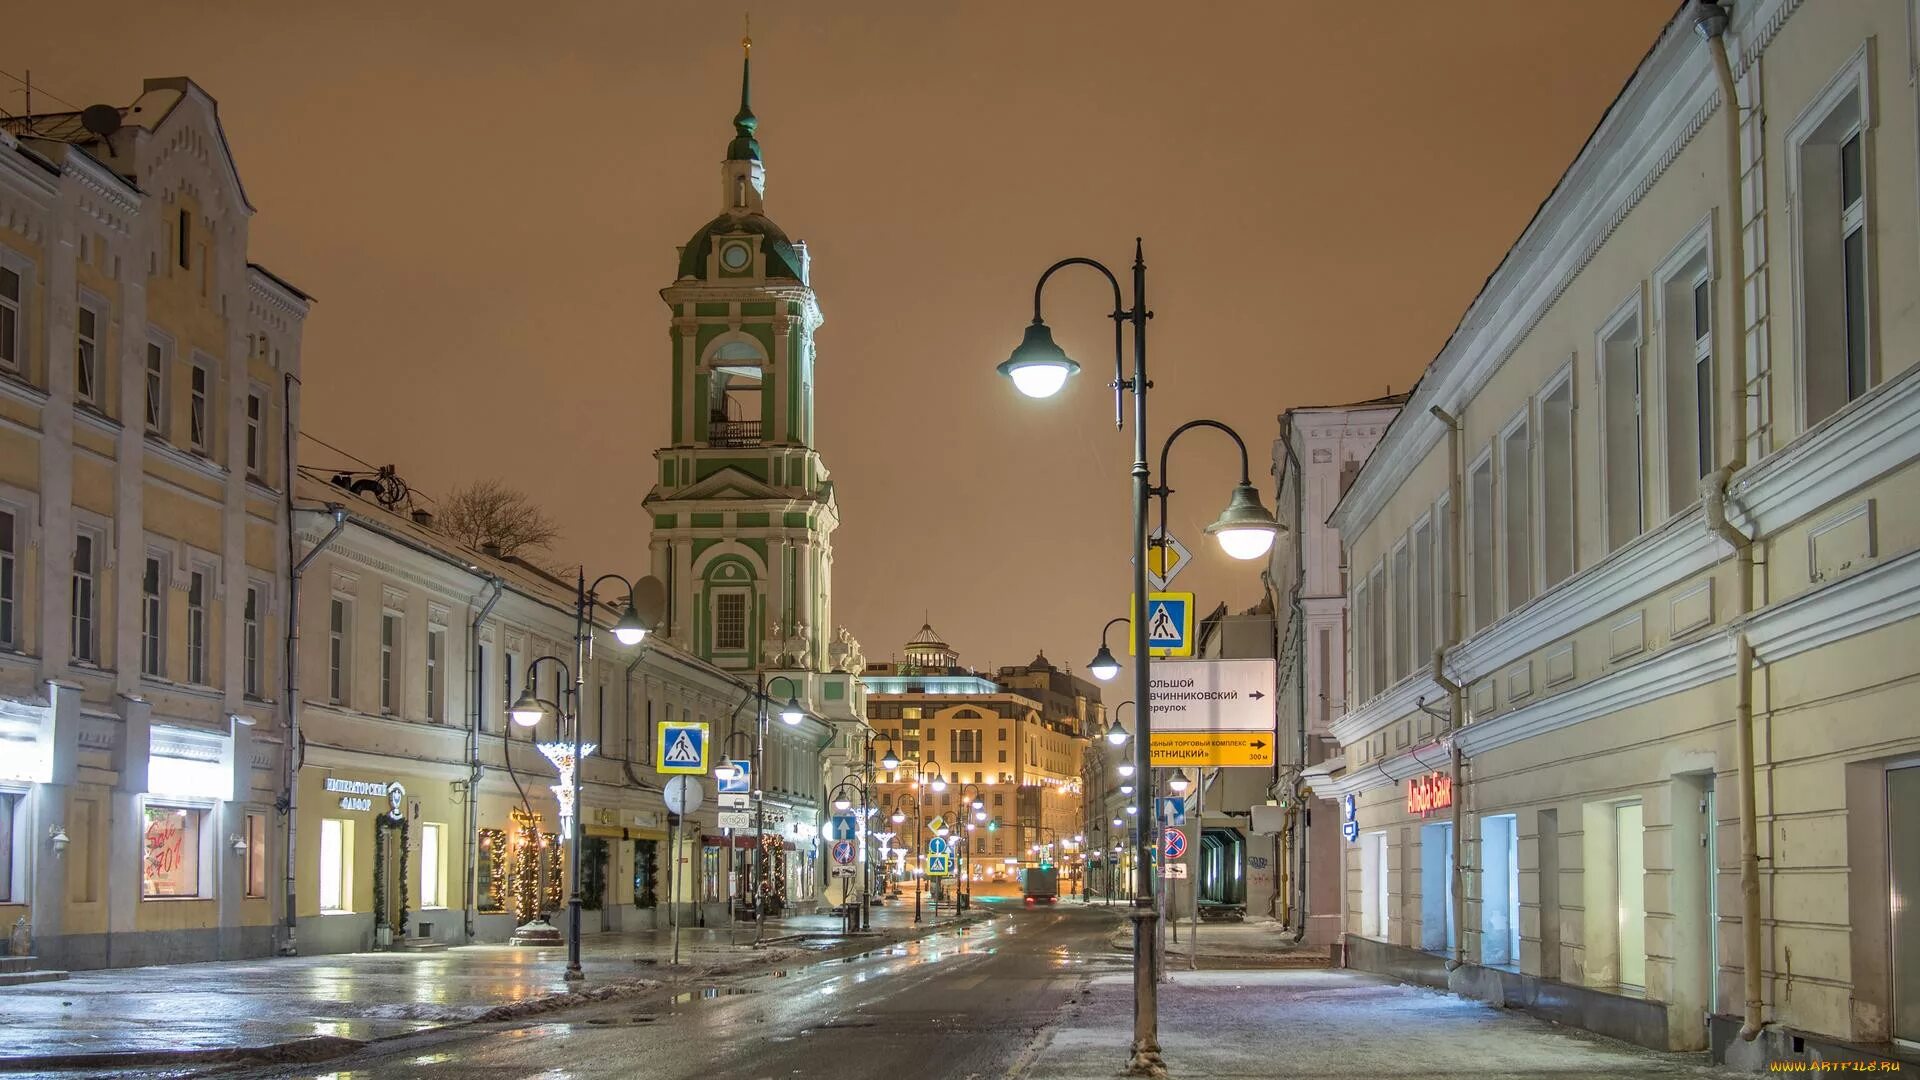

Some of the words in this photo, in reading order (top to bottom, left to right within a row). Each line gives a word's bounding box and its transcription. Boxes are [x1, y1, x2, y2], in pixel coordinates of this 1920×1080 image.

[1149, 679, 1194, 688] ОЛЬШОЙ
[1150, 690, 1238, 700] ВЧИННИКОВСКИЙ
[1149, 705, 1187, 713] ереулок
[1150, 749, 1209, 759] ПЯТНИЦКИЙ»
[326, 778, 387, 796] ИМПЕРАТОРСКИЙ
